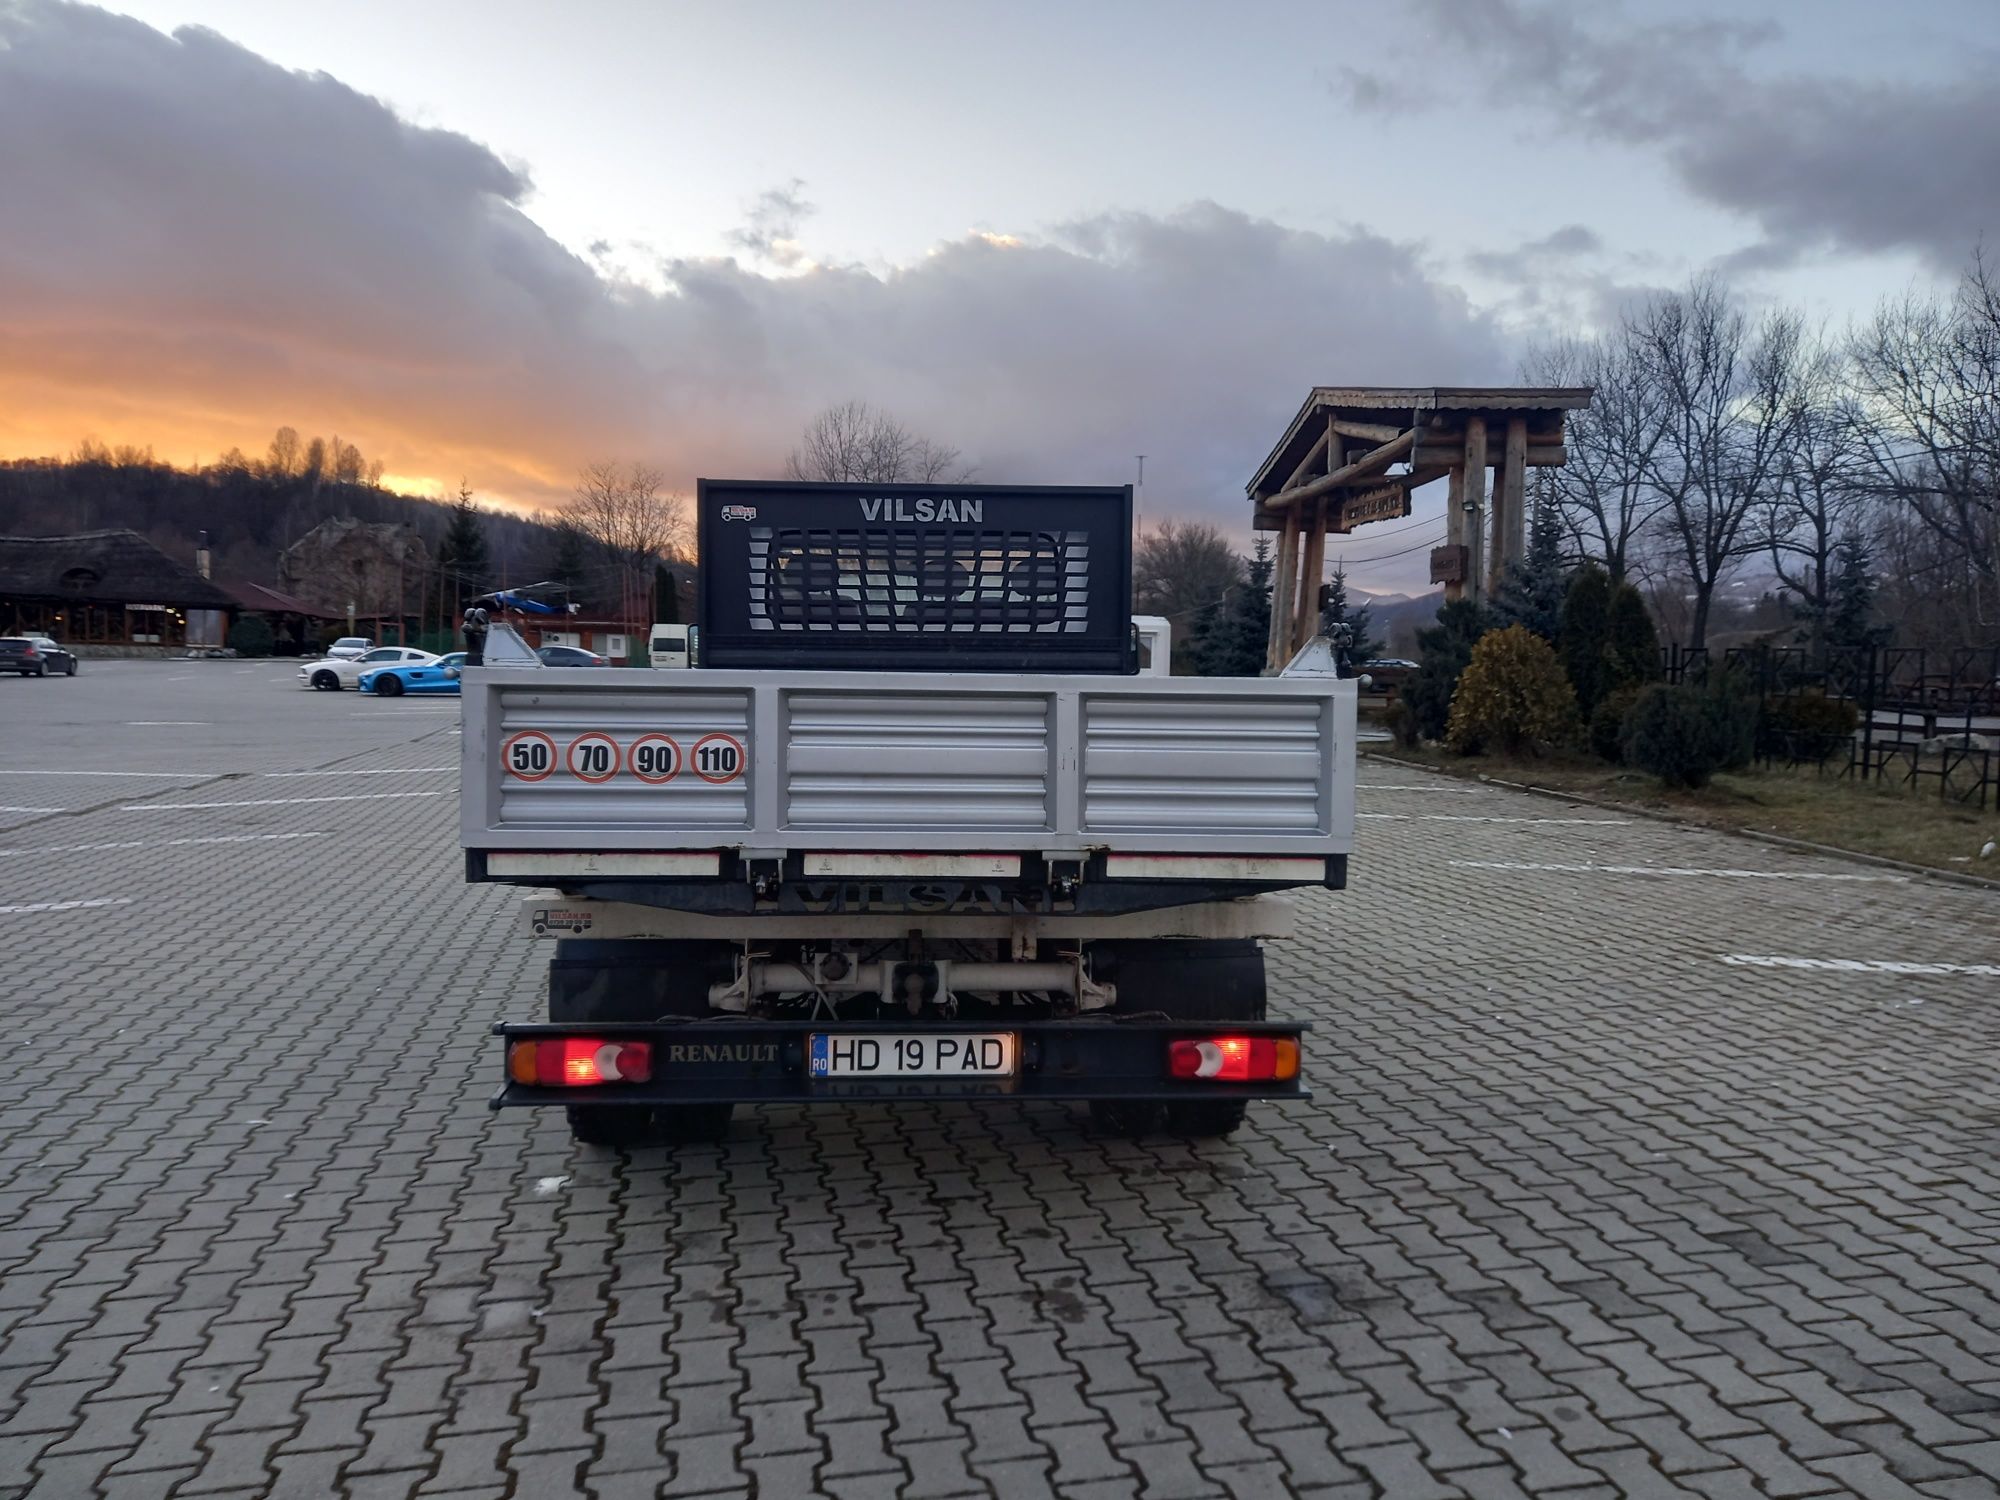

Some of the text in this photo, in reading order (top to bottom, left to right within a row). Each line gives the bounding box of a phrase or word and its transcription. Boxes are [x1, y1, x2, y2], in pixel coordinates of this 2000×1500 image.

[859, 498, 983, 523] VILSAN
[513, 743, 547, 771] 50
[579, 745, 609, 772] 70
[638, 746, 671, 773] 90
[699, 746, 736, 772] 110
[669, 1044, 779, 1063] RENAULT
[812, 1057, 827, 1071] RO
[832, 1039, 1003, 1071] HD 19 PAD
